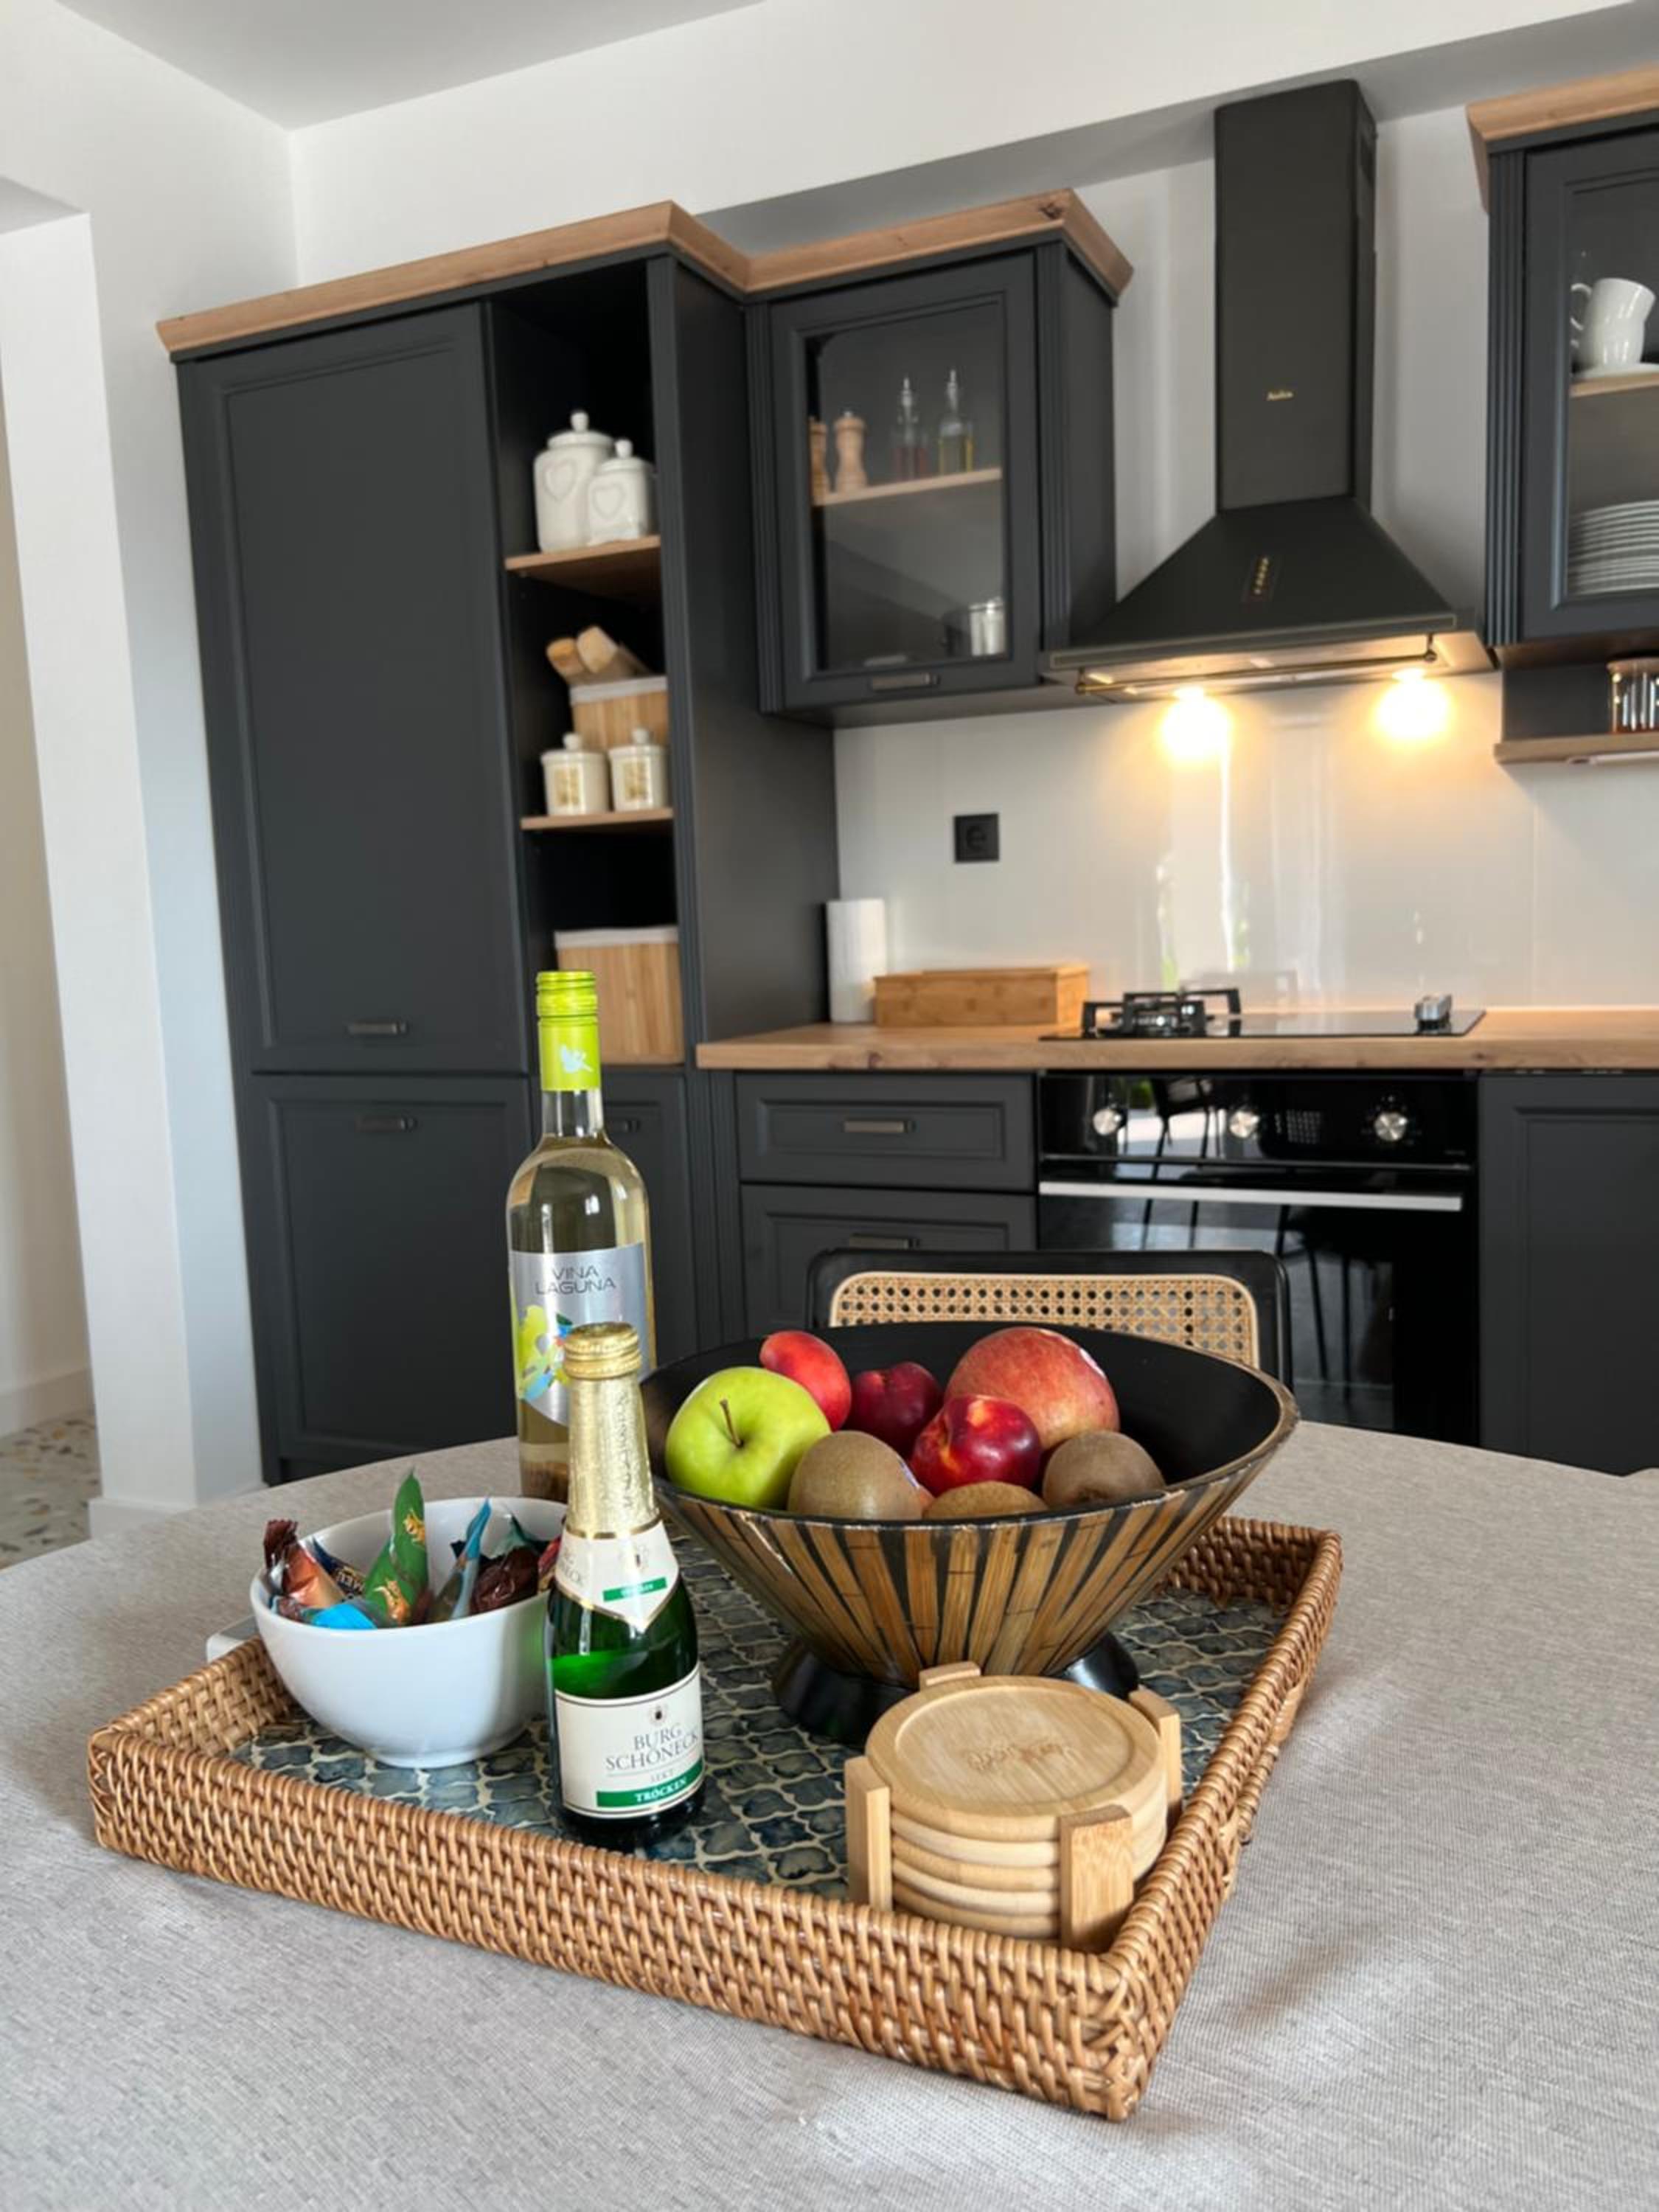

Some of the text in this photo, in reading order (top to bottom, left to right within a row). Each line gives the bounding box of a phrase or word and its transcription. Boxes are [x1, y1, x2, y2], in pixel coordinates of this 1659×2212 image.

[554, 1265, 599, 1280] VINA
[535, 1277, 616, 1295] LAGUNA
[633, 1723, 683, 1751] BURG
[633, 1775, 687, 1804] TROCKEN
